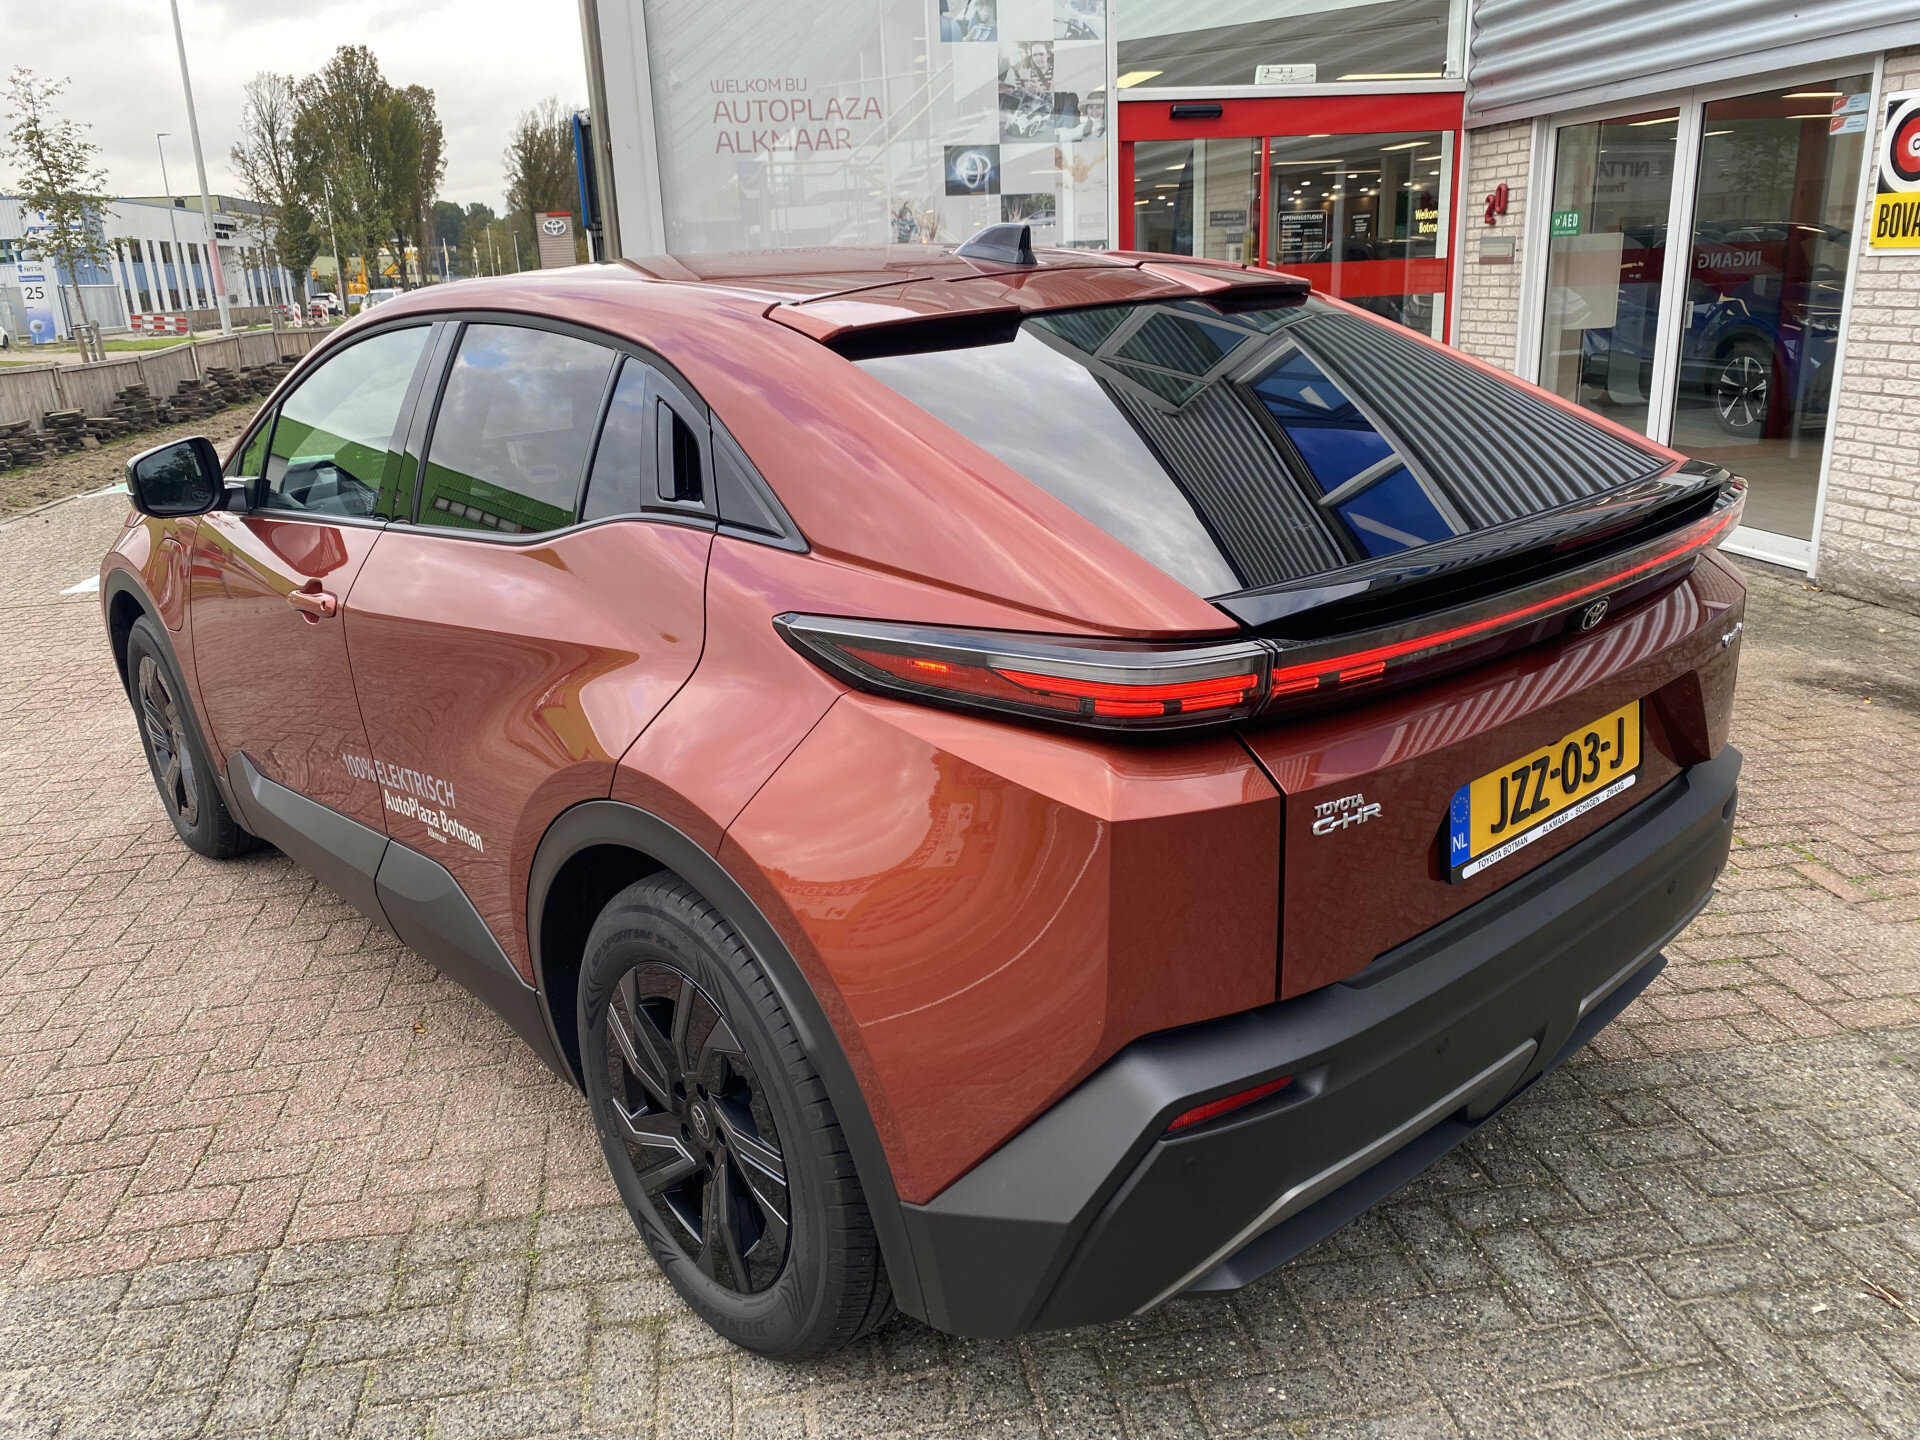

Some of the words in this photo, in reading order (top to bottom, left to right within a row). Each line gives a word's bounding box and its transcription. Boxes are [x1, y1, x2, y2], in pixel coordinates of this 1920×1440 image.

[710, 78, 781, 94] WELKOM
[785, 77, 807, 92] BIJ
[713, 97, 883, 124] AUTOPLAZA
[715, 128, 852, 154] ALKMAAR
[1484, 183, 1509, 226] 20
[1419, 221, 1438, 233] Botma
[1562, 213, 1578, 228] AED
[25, 287, 44, 300] 25
[342, 753, 377, 783] 100%
[374, 759, 456, 809] ELEKTRISCH
[1490, 717, 1625, 834] JZZ-03-J
[1314, 793, 1365, 818] TOYOTA
[384, 789, 440, 829] AutoPlaza
[439, 810, 484, 853] Botman
[1477, 850, 1502, 870] TOYOTA
[1503, 835, 1528, 856] BOTMAN
[1542, 812, 1569, 834] ALKMAAR
[1575, 795, 1600, 816] SCHAGEN
[1606, 782, 1625, 798] ZWAAG
[1453, 832, 1468, 853] NL
